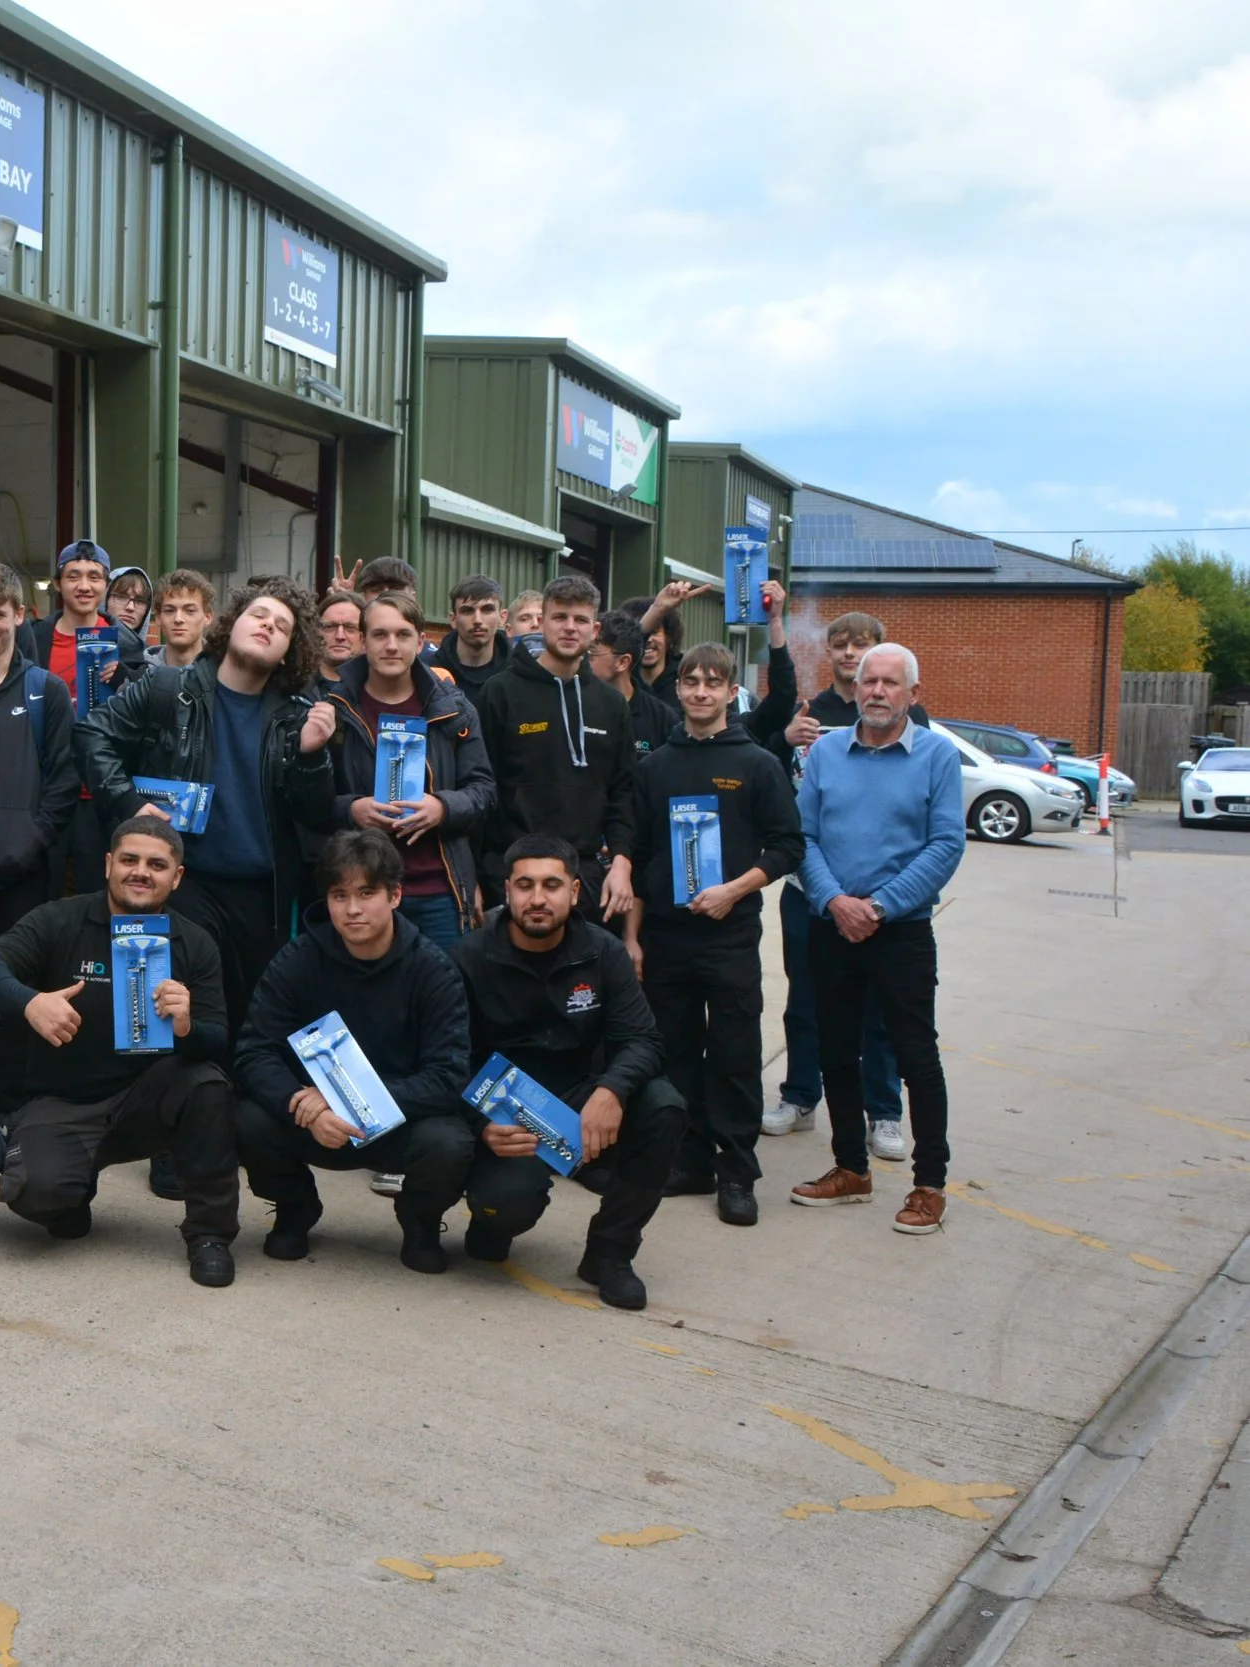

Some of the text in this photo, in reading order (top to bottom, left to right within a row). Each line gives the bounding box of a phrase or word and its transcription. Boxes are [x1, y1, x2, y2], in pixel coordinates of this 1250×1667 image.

[0, 159, 32, 194] BAY
[289, 281, 318, 311] CLASS
[381, 722, 406, 731] LASER
[198, 787, 209, 811] LASER
[672, 804, 697, 812] LASER
[115, 924, 144, 934] LASER
[81, 960, 105, 974] HiQ
[295, 1032, 323, 1050] LASER
[471, 1078, 494, 1104] LASER
